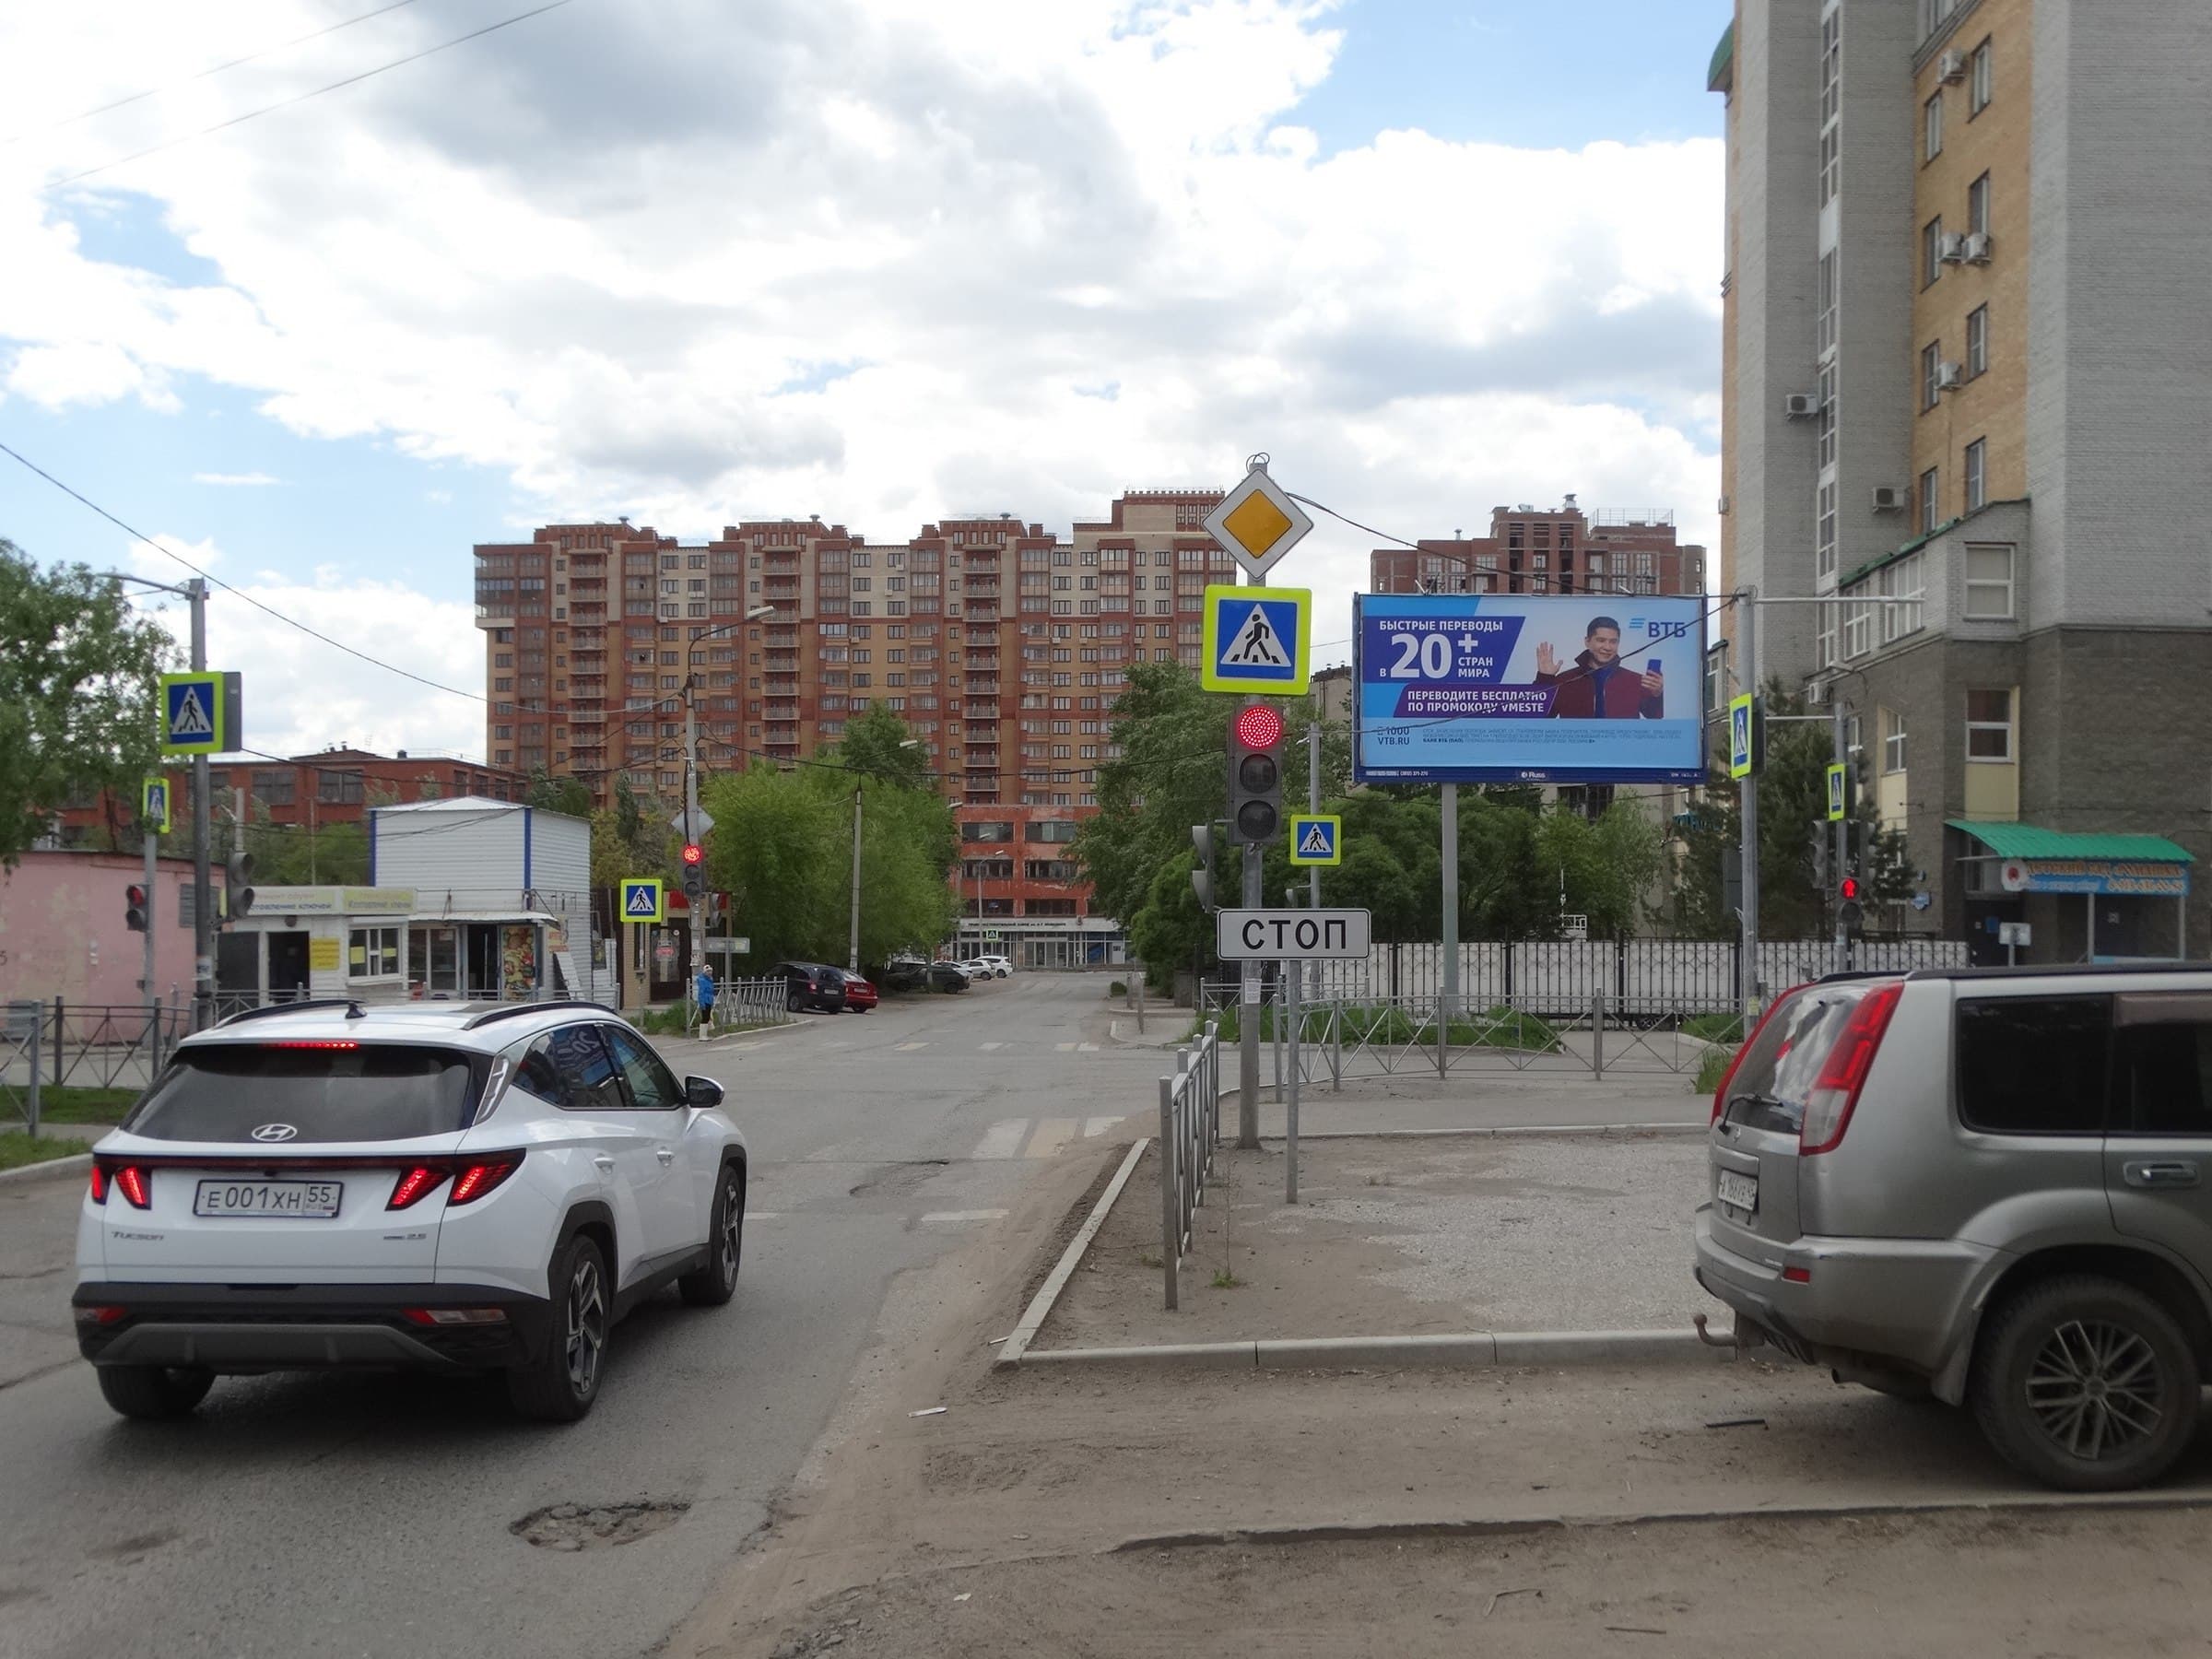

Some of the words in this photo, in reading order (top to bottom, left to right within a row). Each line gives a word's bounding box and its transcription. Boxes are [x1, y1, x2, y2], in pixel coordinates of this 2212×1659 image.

[1379, 620, 1436, 630] БЫСТРЫЕ
[1440, 620, 1503, 632] ПЕРЕВОДЫ
[1648, 621, 1687, 638] ВТБ
[1458, 657, 1493, 666] СТРАН
[1458, 668, 1490, 677] МИРА
[1407, 691, 1478, 701] ПЕРЕВОДИТЕ
[1482, 691, 1547, 701] БЕСПЛАТНО
[1407, 702, 1424, 712] ПО
[1427, 702, 1499, 713] ПРОМОКОДУ
[1377, 736, 1410, 746] VTB.RU
[1242, 919, 1346, 949] СТОП
[308, 1186, 331, 1203] 55
